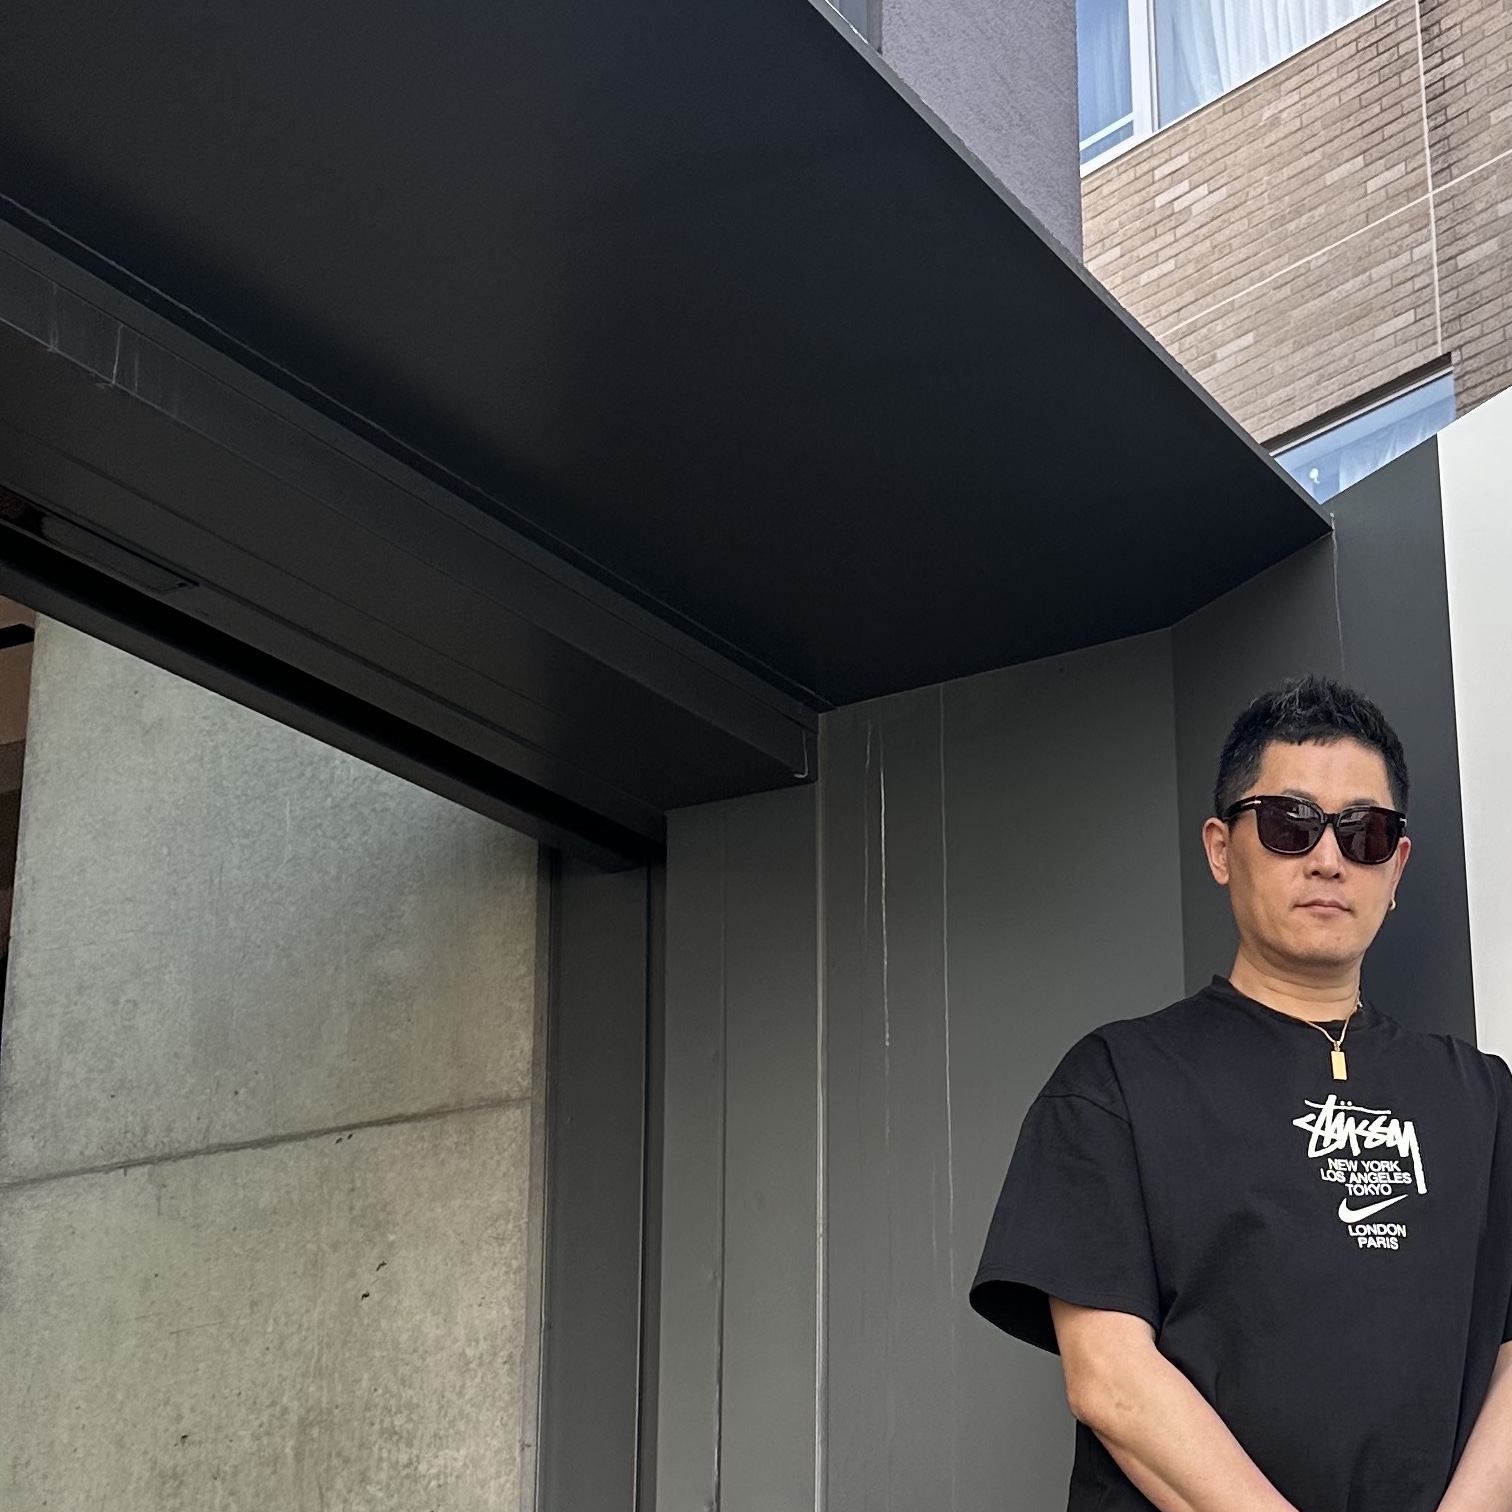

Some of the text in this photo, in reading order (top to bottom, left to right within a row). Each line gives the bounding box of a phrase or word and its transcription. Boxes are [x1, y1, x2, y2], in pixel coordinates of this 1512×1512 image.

[1328, 1157, 1401, 1172] NEW YORK
[1320, 1168, 1412, 1184] LOS ANGELES
[1345, 1183, 1392, 1196] TOKYO
[1348, 1223, 1407, 1238] LONDON
[1357, 1236, 1399, 1251] PARIS
